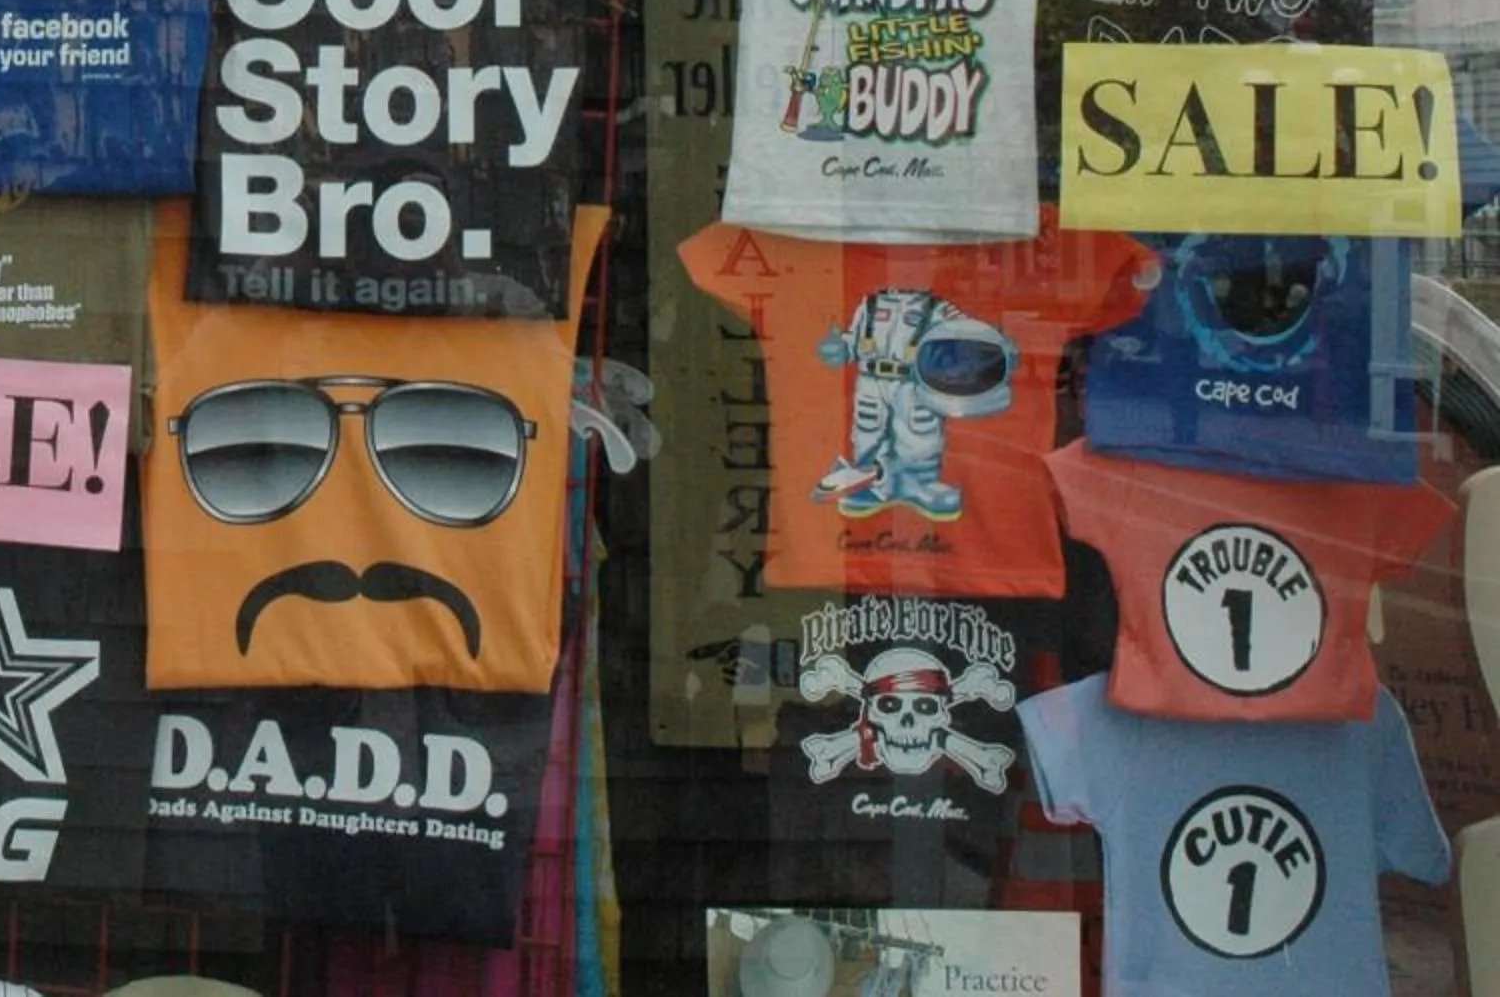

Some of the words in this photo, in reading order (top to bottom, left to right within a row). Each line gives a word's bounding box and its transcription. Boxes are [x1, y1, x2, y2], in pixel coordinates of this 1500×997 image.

[0, 48, 54, 72] your
[60, 43, 130, 66] friend
[1, 12, 129, 39] facebook
[848, 13, 970, 43] LITTLE
[216, 37, 580, 167] Story
[848, 62, 987, 144] BUDDY
[1078, 79, 1438, 181] SALE!
[219, 153, 491, 261] Bro.
[17, 283, 55, 301] than
[218, 265, 293, 302] Tell
[310, 267, 339, 302] it
[1195, 379, 1249, 408] Cape
[1255, 385, 1300, 409] Cod
[1176, 537, 1307, 602] TROUBLE
[800, 595, 892, 666] Pirate
[891, 595, 949, 640] For
[948, 602, 1016, 672] Hire
[1221, 588, 1253, 671] 1
[150, 714, 508, 818] D.A.D.D.
[203, 800, 292, 824] Against
[299, 807, 418, 835] Daughters
[425, 819, 505, 850] Dating
[1185, 805, 1310, 880] CUTIE
[1227, 861, 1257, 935] 1
[944, 965, 1049, 994] Practice
